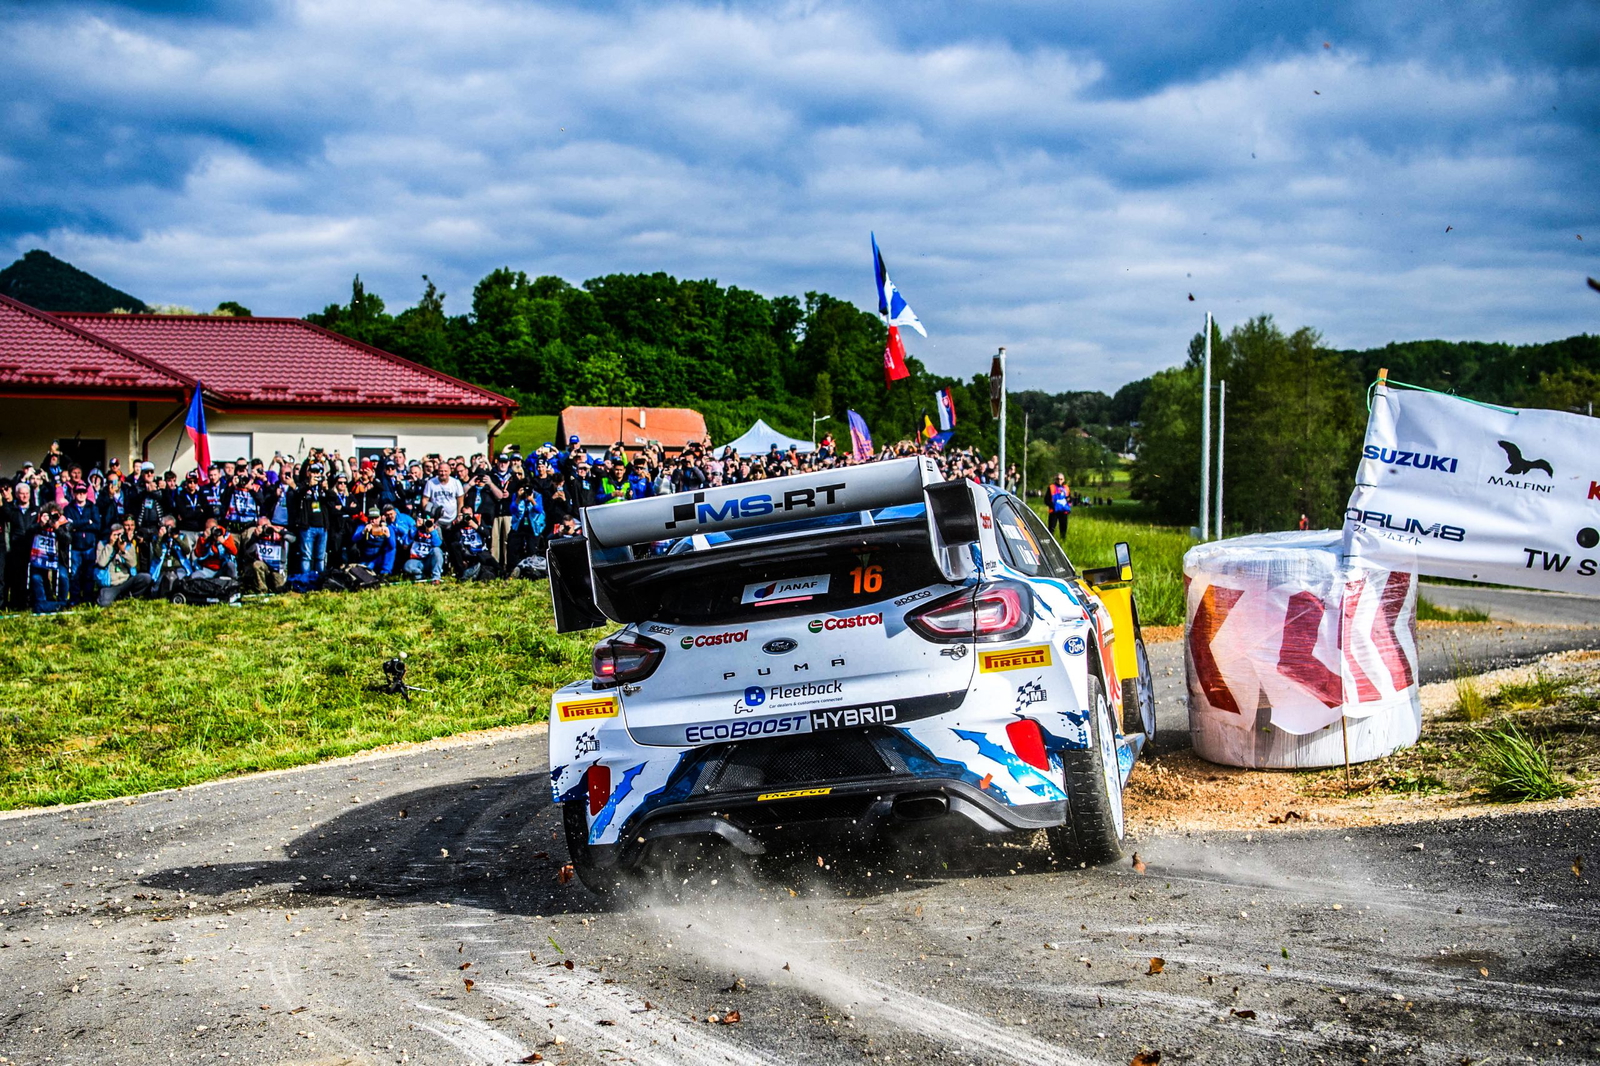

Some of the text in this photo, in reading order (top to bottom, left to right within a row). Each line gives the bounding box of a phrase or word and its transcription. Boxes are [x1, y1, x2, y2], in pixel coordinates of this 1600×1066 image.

[1362, 444, 1459, 474] SUZUKI
[697, 483, 846, 524] MS-RT
[1523, 548, 1571, 573] TW
[778, 581, 818, 594] JANAF
[850, 564, 884, 594] 16
[894, 590, 933, 608] sparco
[824, 612, 883, 631] Castrol
[695, 629, 749, 648] Castrol
[723, 658, 846, 681] PUMA
[985, 649, 1045, 670] PIRELLI
[769, 679, 843, 701] Fleetback
[562, 701, 614, 718] PIRELLI
[685, 704, 897, 743] ECOBOOST HYBRID
